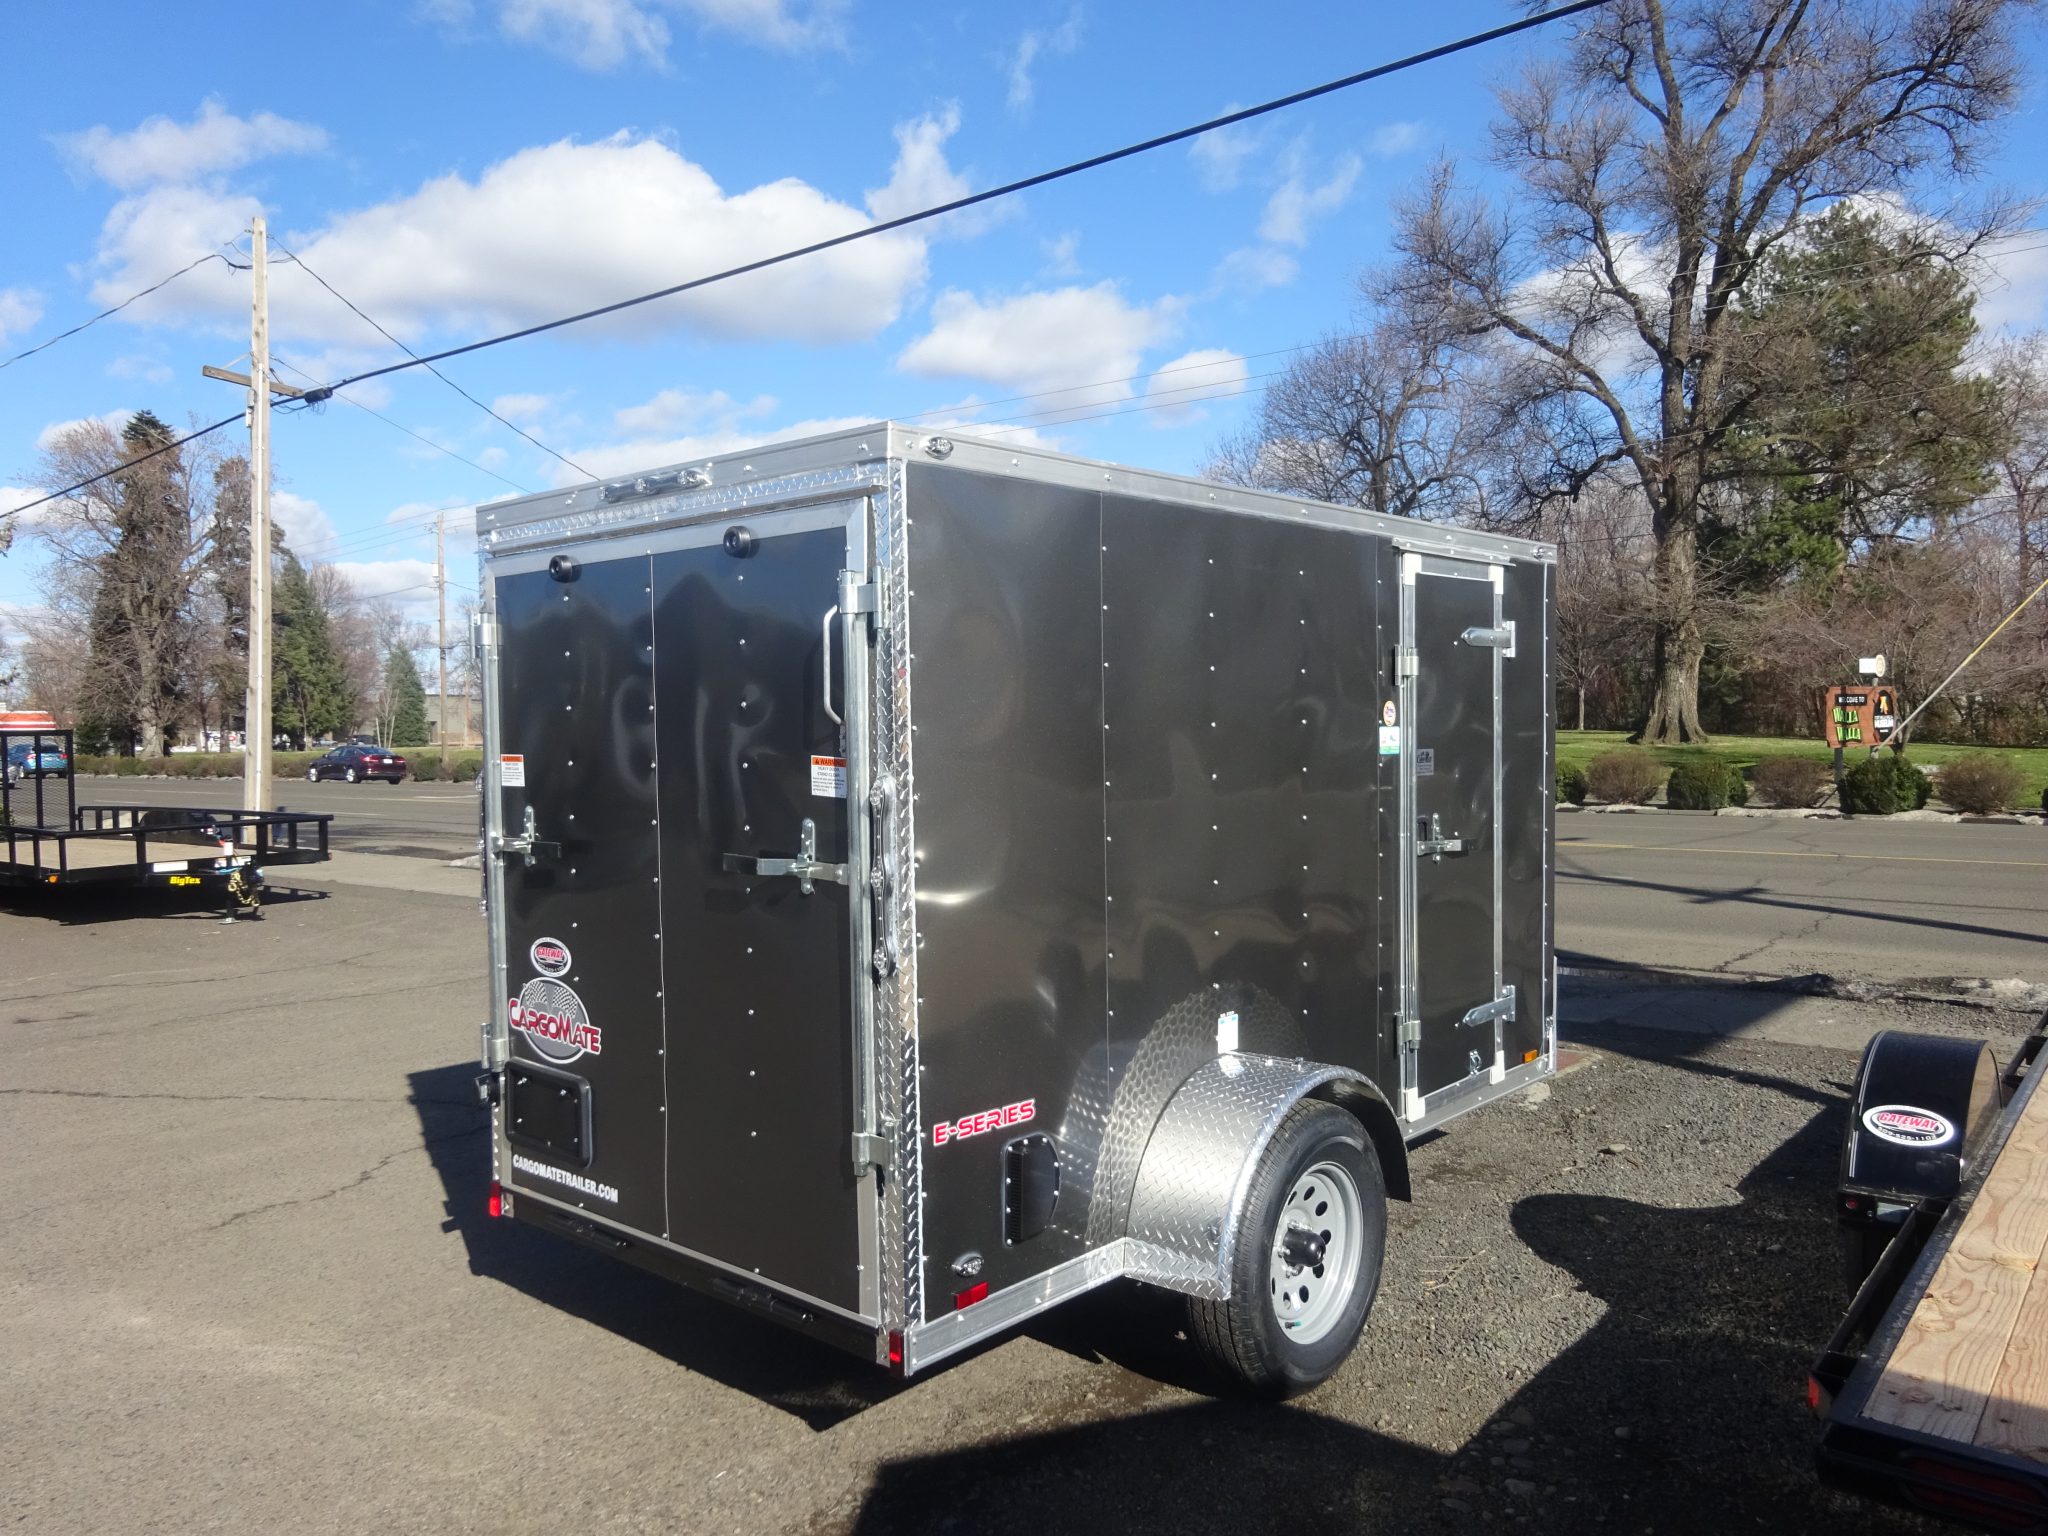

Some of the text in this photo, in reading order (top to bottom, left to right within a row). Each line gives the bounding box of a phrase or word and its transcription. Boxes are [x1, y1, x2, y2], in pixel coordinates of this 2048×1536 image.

[169, 876, 201, 886] BigTex
[536, 946, 565, 960] GATEWAY
[933, 1098, 1036, 1147] E-SERIES
[1878, 1111, 1939, 1130] GATEWAY
[513, 1154, 618, 1203] CARGOMATETRAILER.COM
